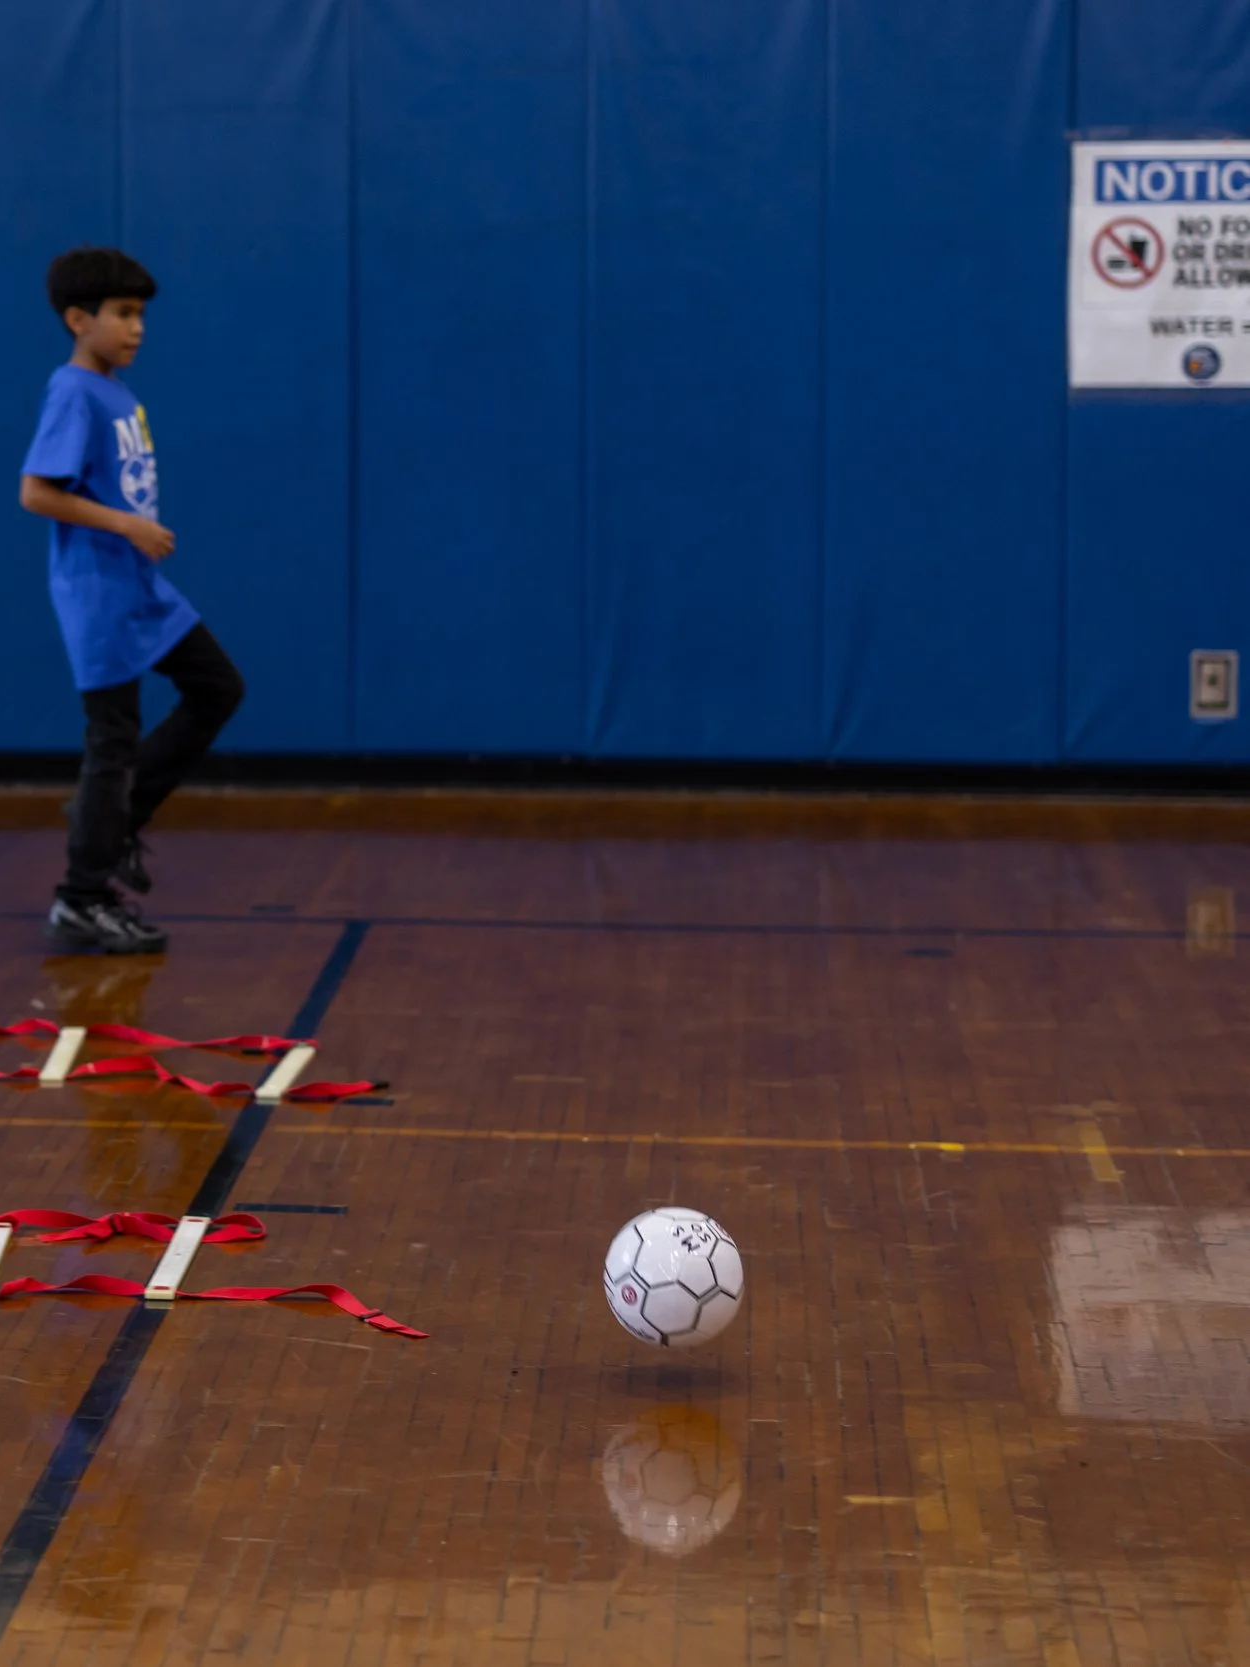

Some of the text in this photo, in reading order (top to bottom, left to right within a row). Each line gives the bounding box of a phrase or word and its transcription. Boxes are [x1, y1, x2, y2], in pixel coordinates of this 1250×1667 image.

[1103, 161, 1250, 200] NOTIC
[1177, 217, 1212, 237] NO
[1172, 242, 1206, 262] OR
[1150, 317, 1234, 337] WATER
